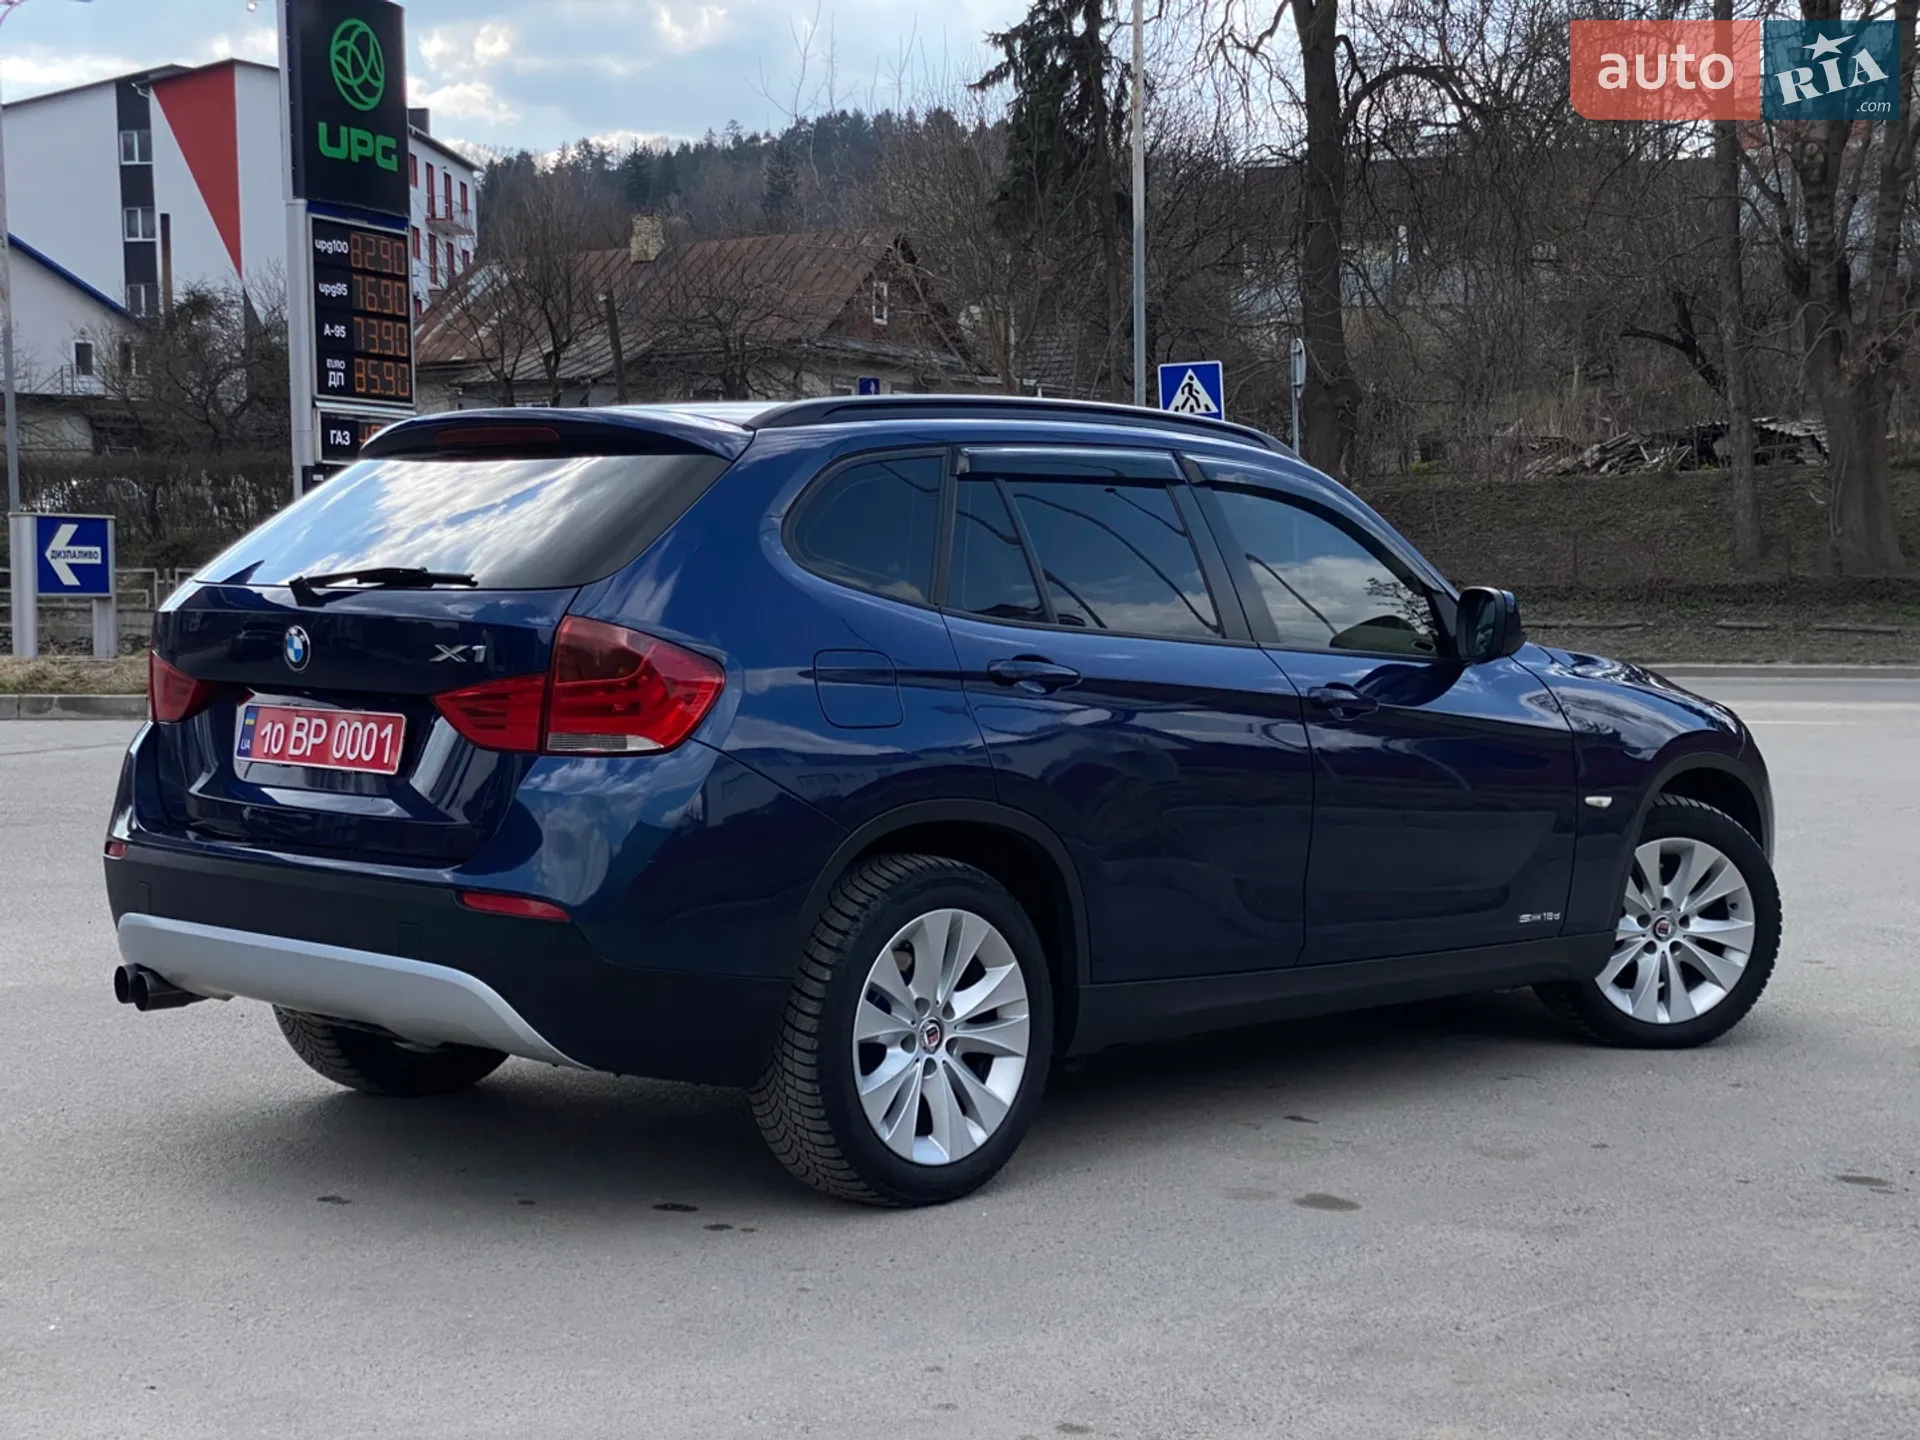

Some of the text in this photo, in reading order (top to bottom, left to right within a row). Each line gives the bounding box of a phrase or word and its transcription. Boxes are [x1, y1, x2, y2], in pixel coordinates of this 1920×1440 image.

[318, 121, 398, 173] UPG
[315, 239, 349, 254] upg100
[319, 283, 348, 297] upg95
[352, 316, 409, 356] 73.90
[327, 358, 345, 370] EURO
[328, 358, 410, 396] ДП 85.90
[330, 430, 350, 445] ГАЗ
[51, 549, 99, 560] ДИЗПАЛИВО
[429, 644, 486, 663] X1
[241, 738, 251, 750] UA
[260, 716, 393, 764] 10 BP 0001
